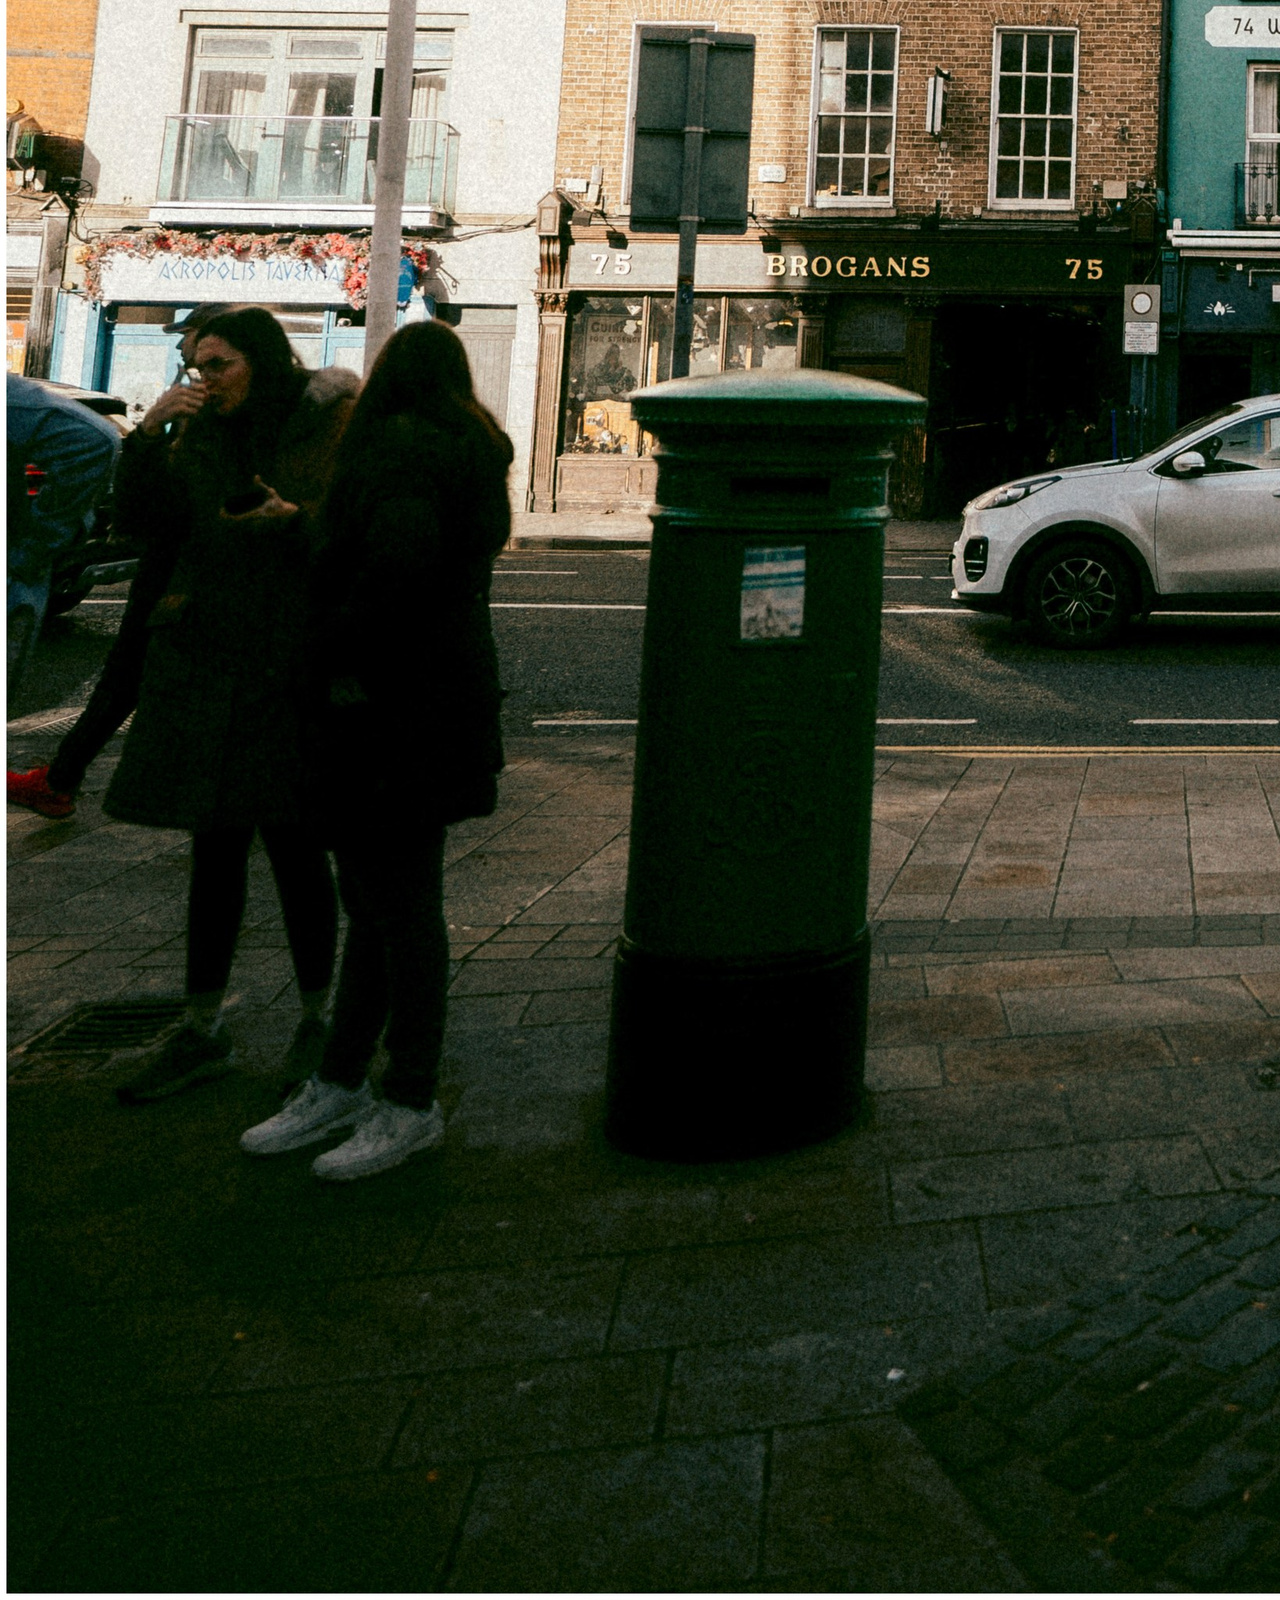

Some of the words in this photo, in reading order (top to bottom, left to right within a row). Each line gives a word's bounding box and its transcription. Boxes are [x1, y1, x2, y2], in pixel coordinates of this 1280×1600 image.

[1233, 18, 1254, 36] 74
[158, 260, 256, 281] ACROPOLIS
[590, 253, 633, 276] 75
[766, 254, 931, 279] BROGANS
[1064, 258, 1104, 281] 75
